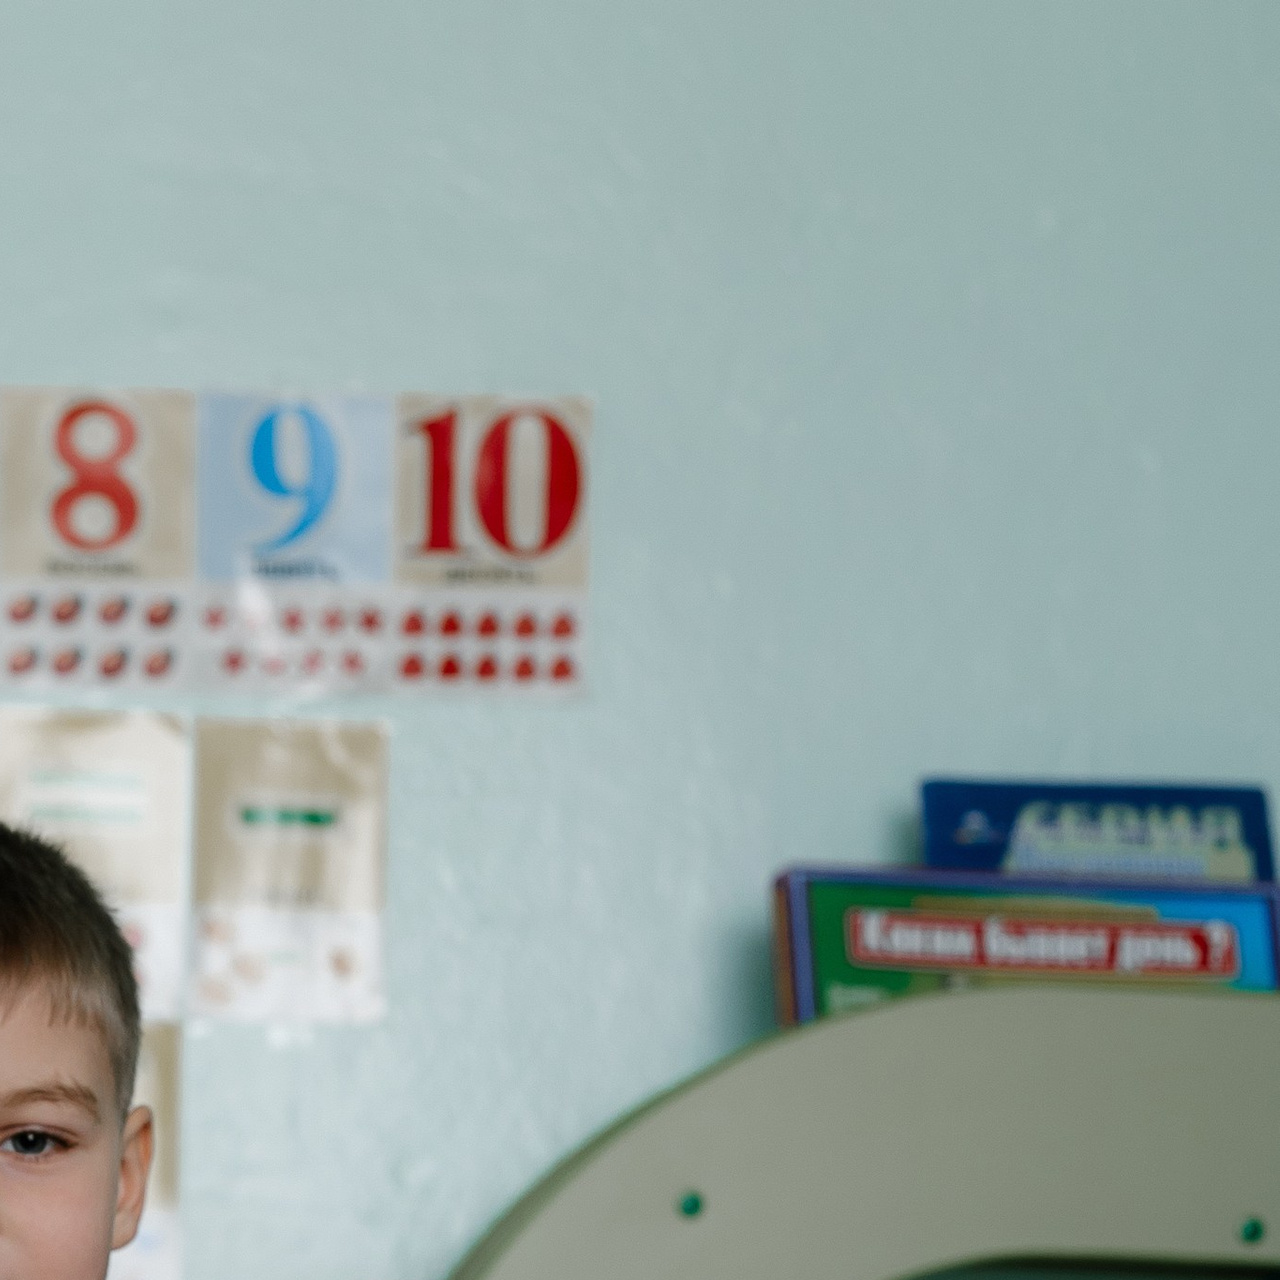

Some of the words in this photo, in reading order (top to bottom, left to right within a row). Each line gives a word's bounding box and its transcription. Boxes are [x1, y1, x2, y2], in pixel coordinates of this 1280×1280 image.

[52, 401, 140, 552] 8
[250, 405, 339, 554] 9
[411, 407, 582, 557] 10
